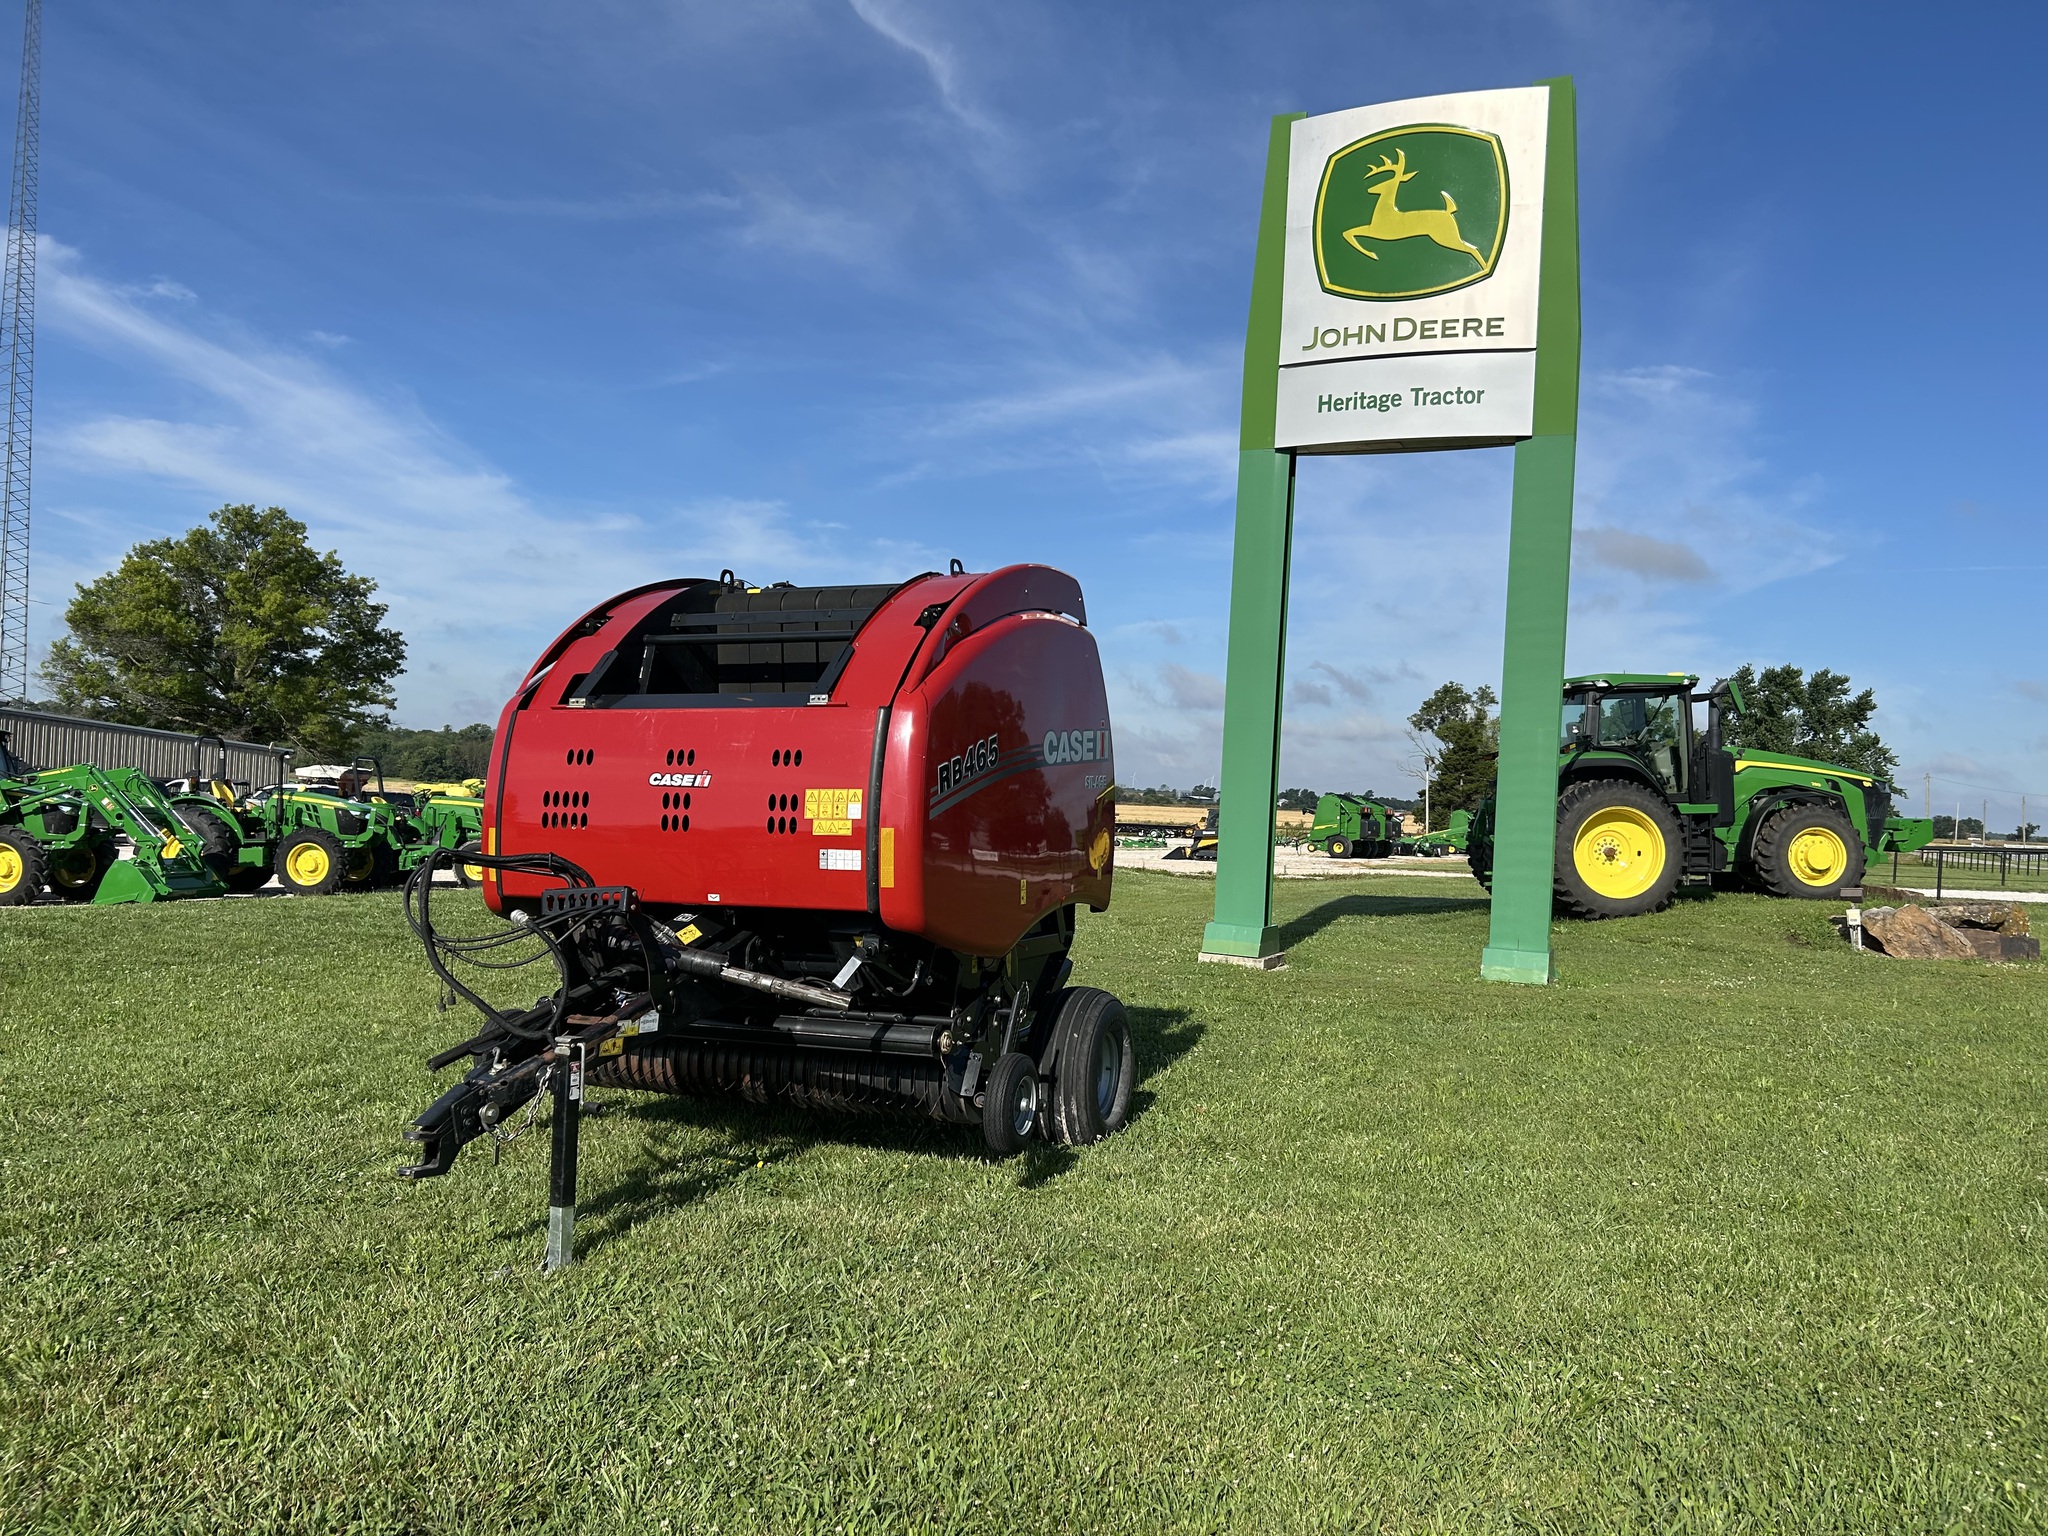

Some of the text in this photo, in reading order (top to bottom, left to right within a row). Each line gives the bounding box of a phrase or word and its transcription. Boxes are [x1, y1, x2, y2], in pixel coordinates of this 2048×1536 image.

[1301, 317, 1505, 351] JOHN DEERE
[1317, 386, 1485, 413] Heritage Tractor
[937, 733, 999, 795] RB465
[1043, 730, 1094, 765] CASE
[648, 772, 696, 787] CASE
